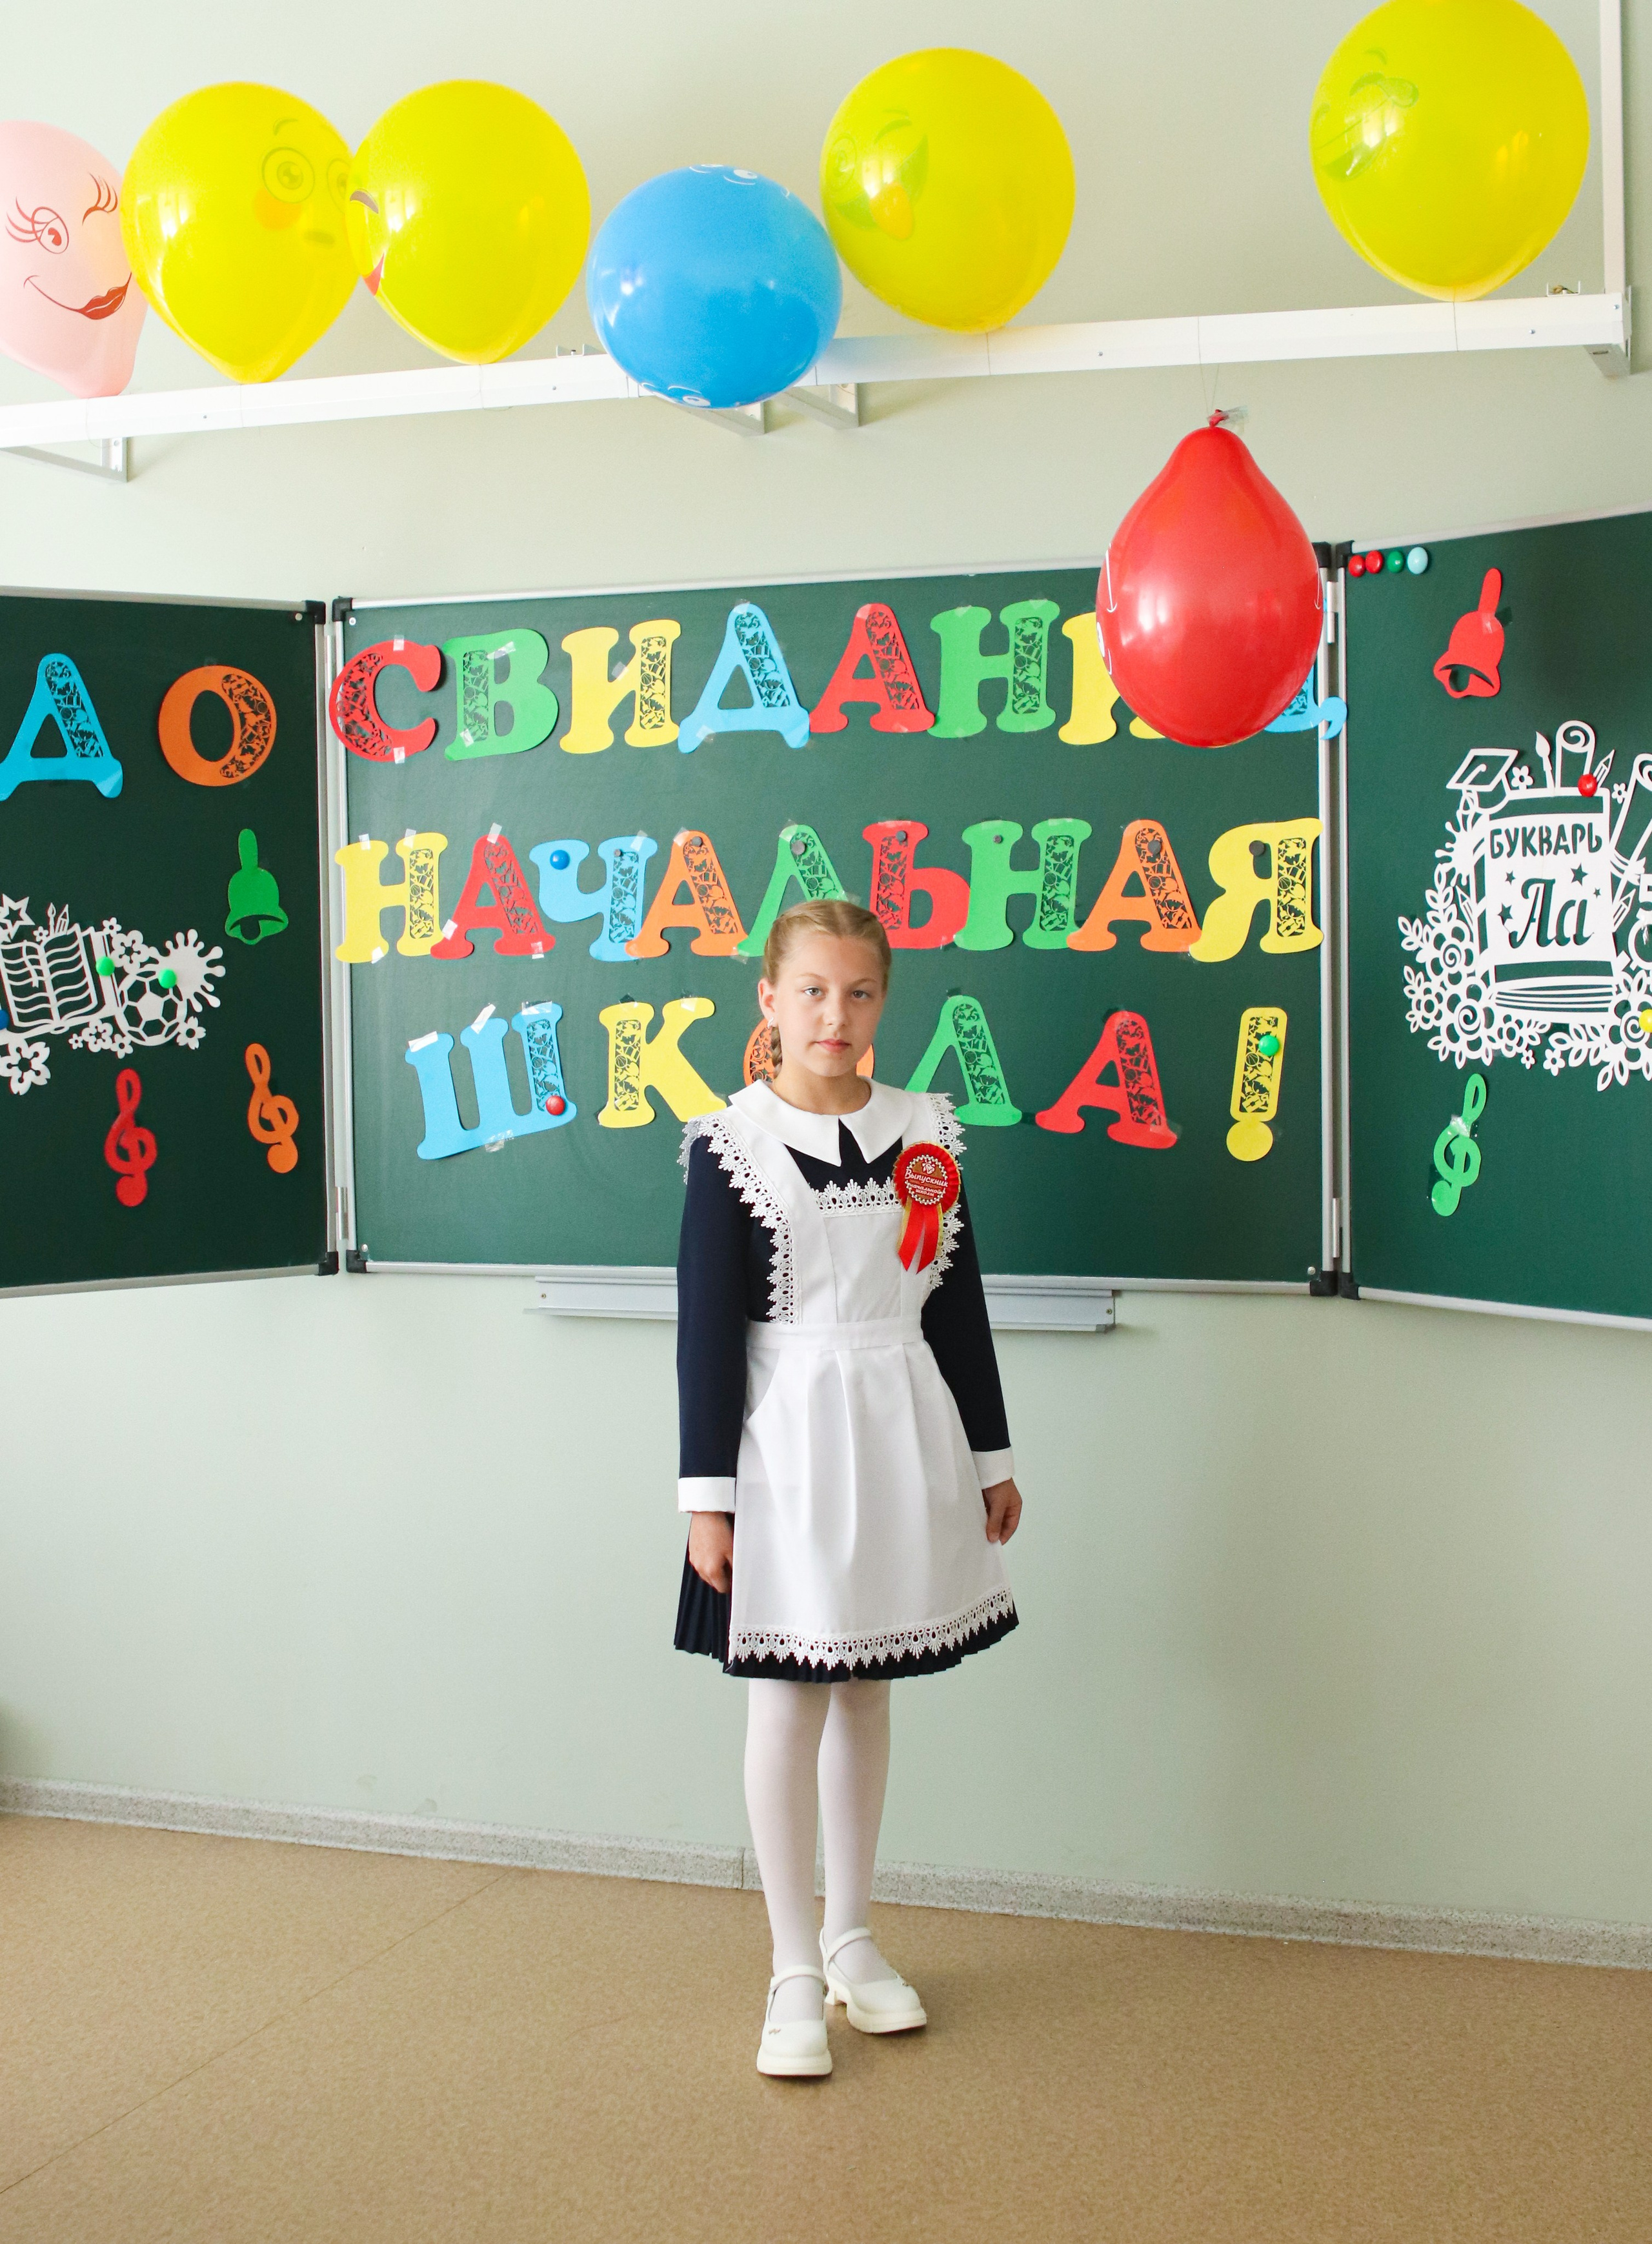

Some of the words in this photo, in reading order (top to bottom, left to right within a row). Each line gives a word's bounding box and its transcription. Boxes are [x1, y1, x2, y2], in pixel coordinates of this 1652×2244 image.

[0, 653, 276, 800] ДО
[1489, 822, 1603, 859] БУКВАРЬ
[335, 818, 1324, 963] НАЧАЛЬНАЯ
[1509, 878, 1595, 949] Аа
[405, 995, 1287, 1162] ШКЛА!
[904, 1168, 948, 1188] Выпускник
[915, 1188, 934, 1197] школы
